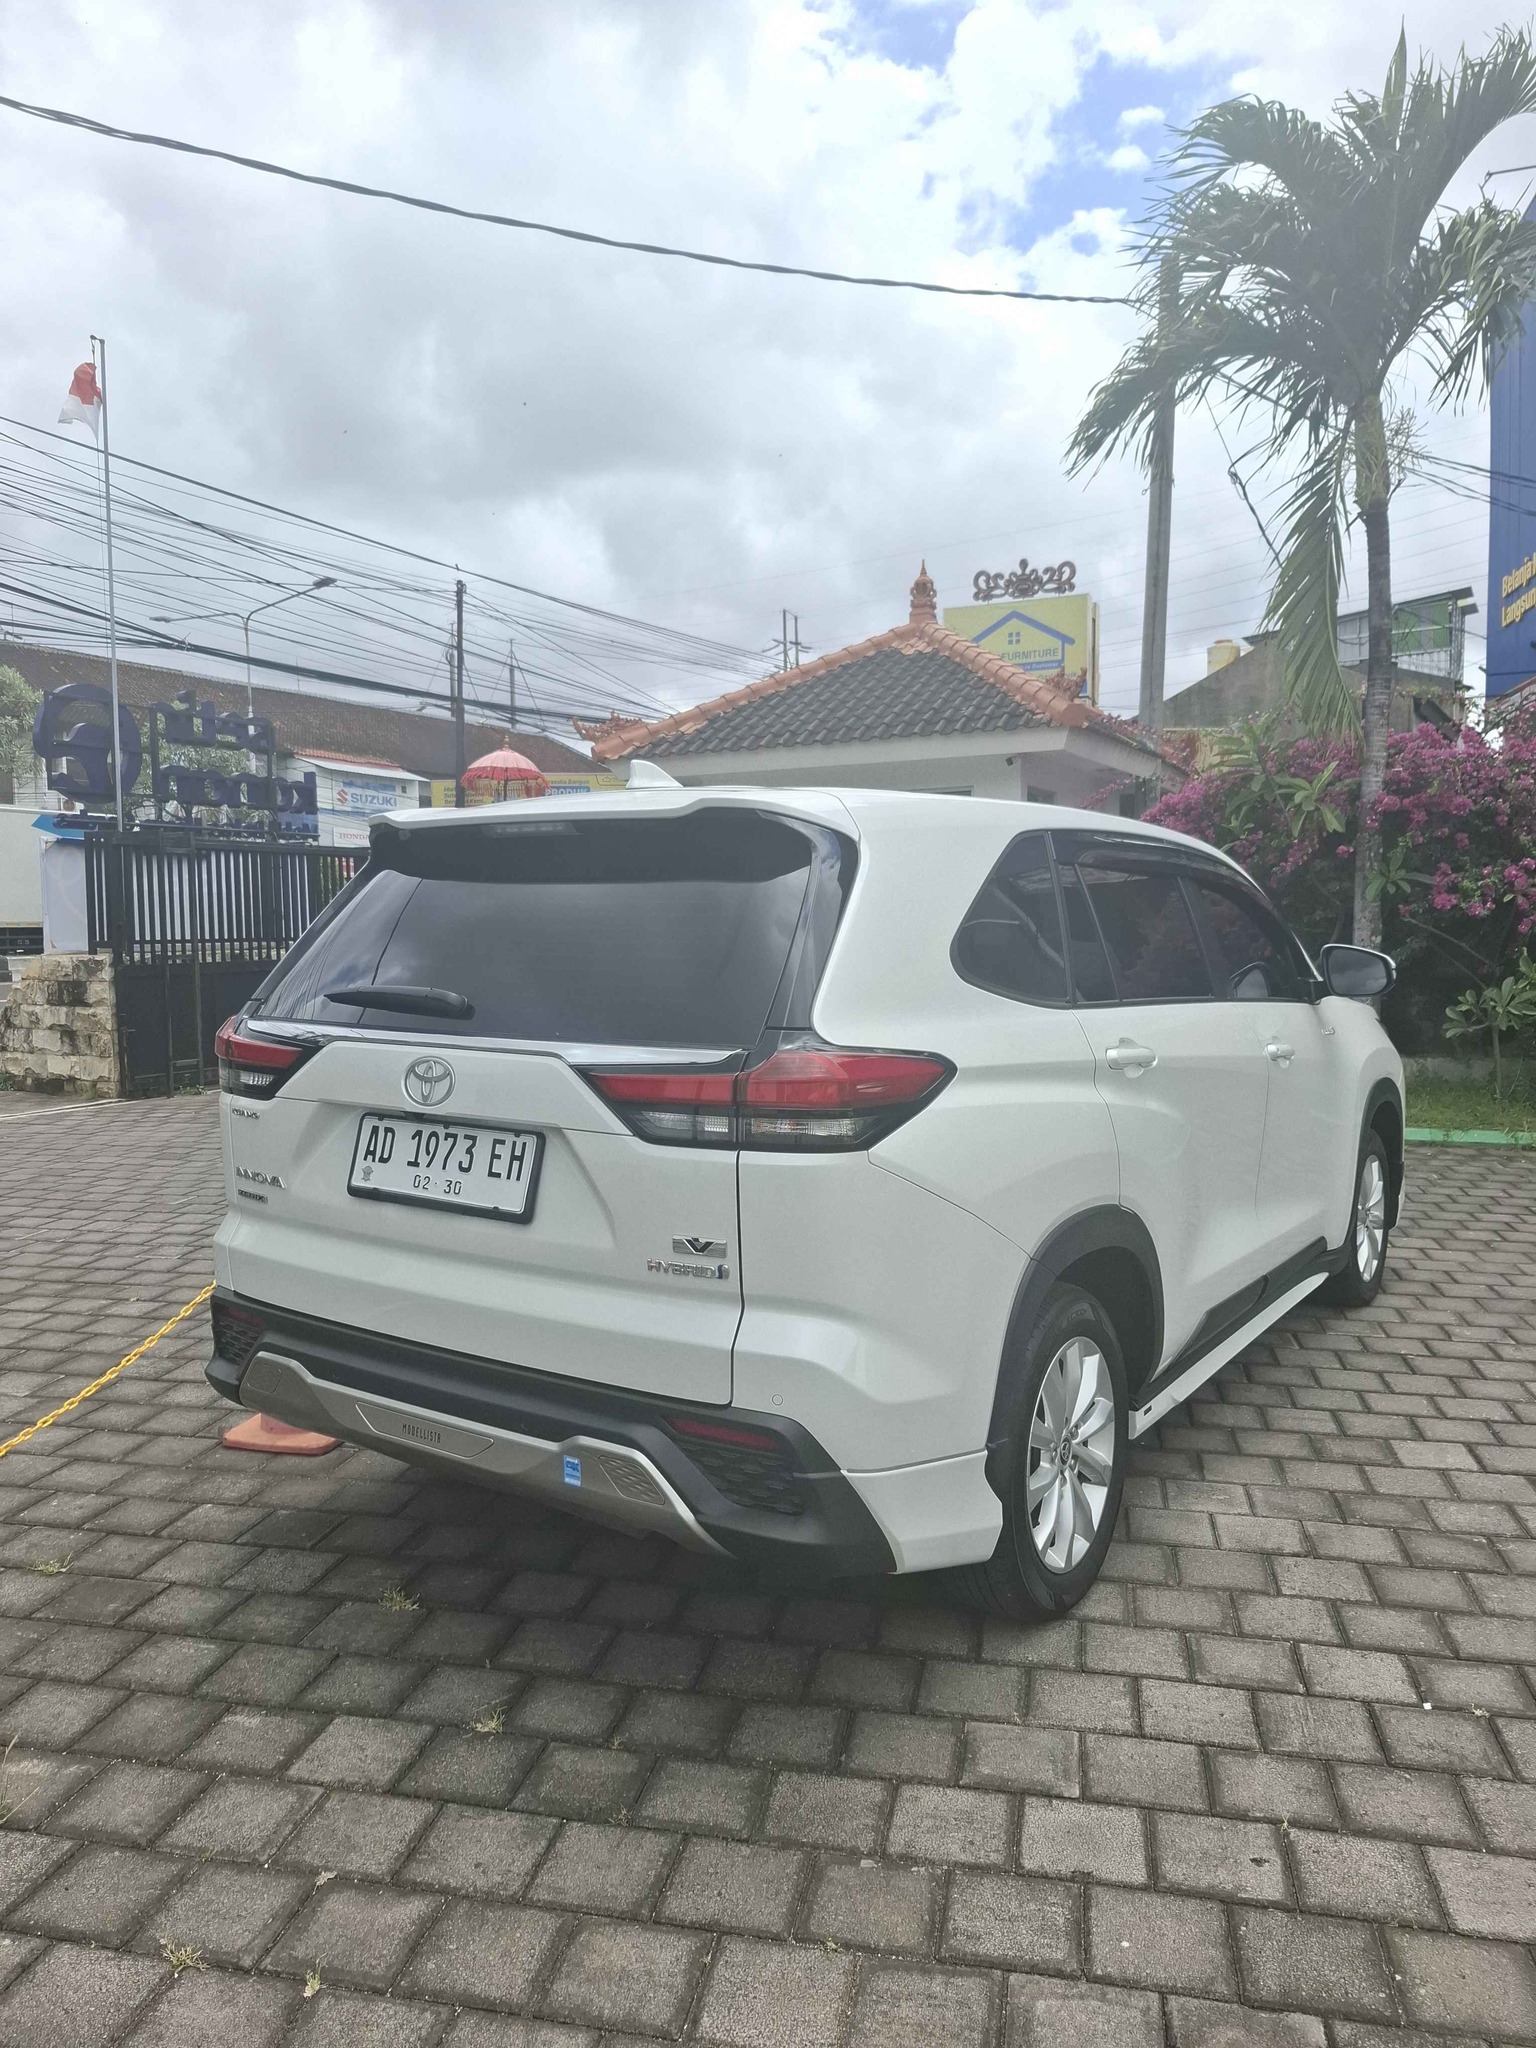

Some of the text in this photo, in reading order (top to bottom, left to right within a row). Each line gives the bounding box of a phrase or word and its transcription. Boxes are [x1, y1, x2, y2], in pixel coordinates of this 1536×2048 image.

[1001, 648, 1059, 661] FURNITURE
[351, 793, 397, 808] SUZUKI
[363, 1125, 527, 1181] AD 1973 EH
[236, 1167, 287, 1189] INNOVA
[647, 1258, 716, 1278] HYBRID
[402, 1423, 442, 1444] MODELLISTA
